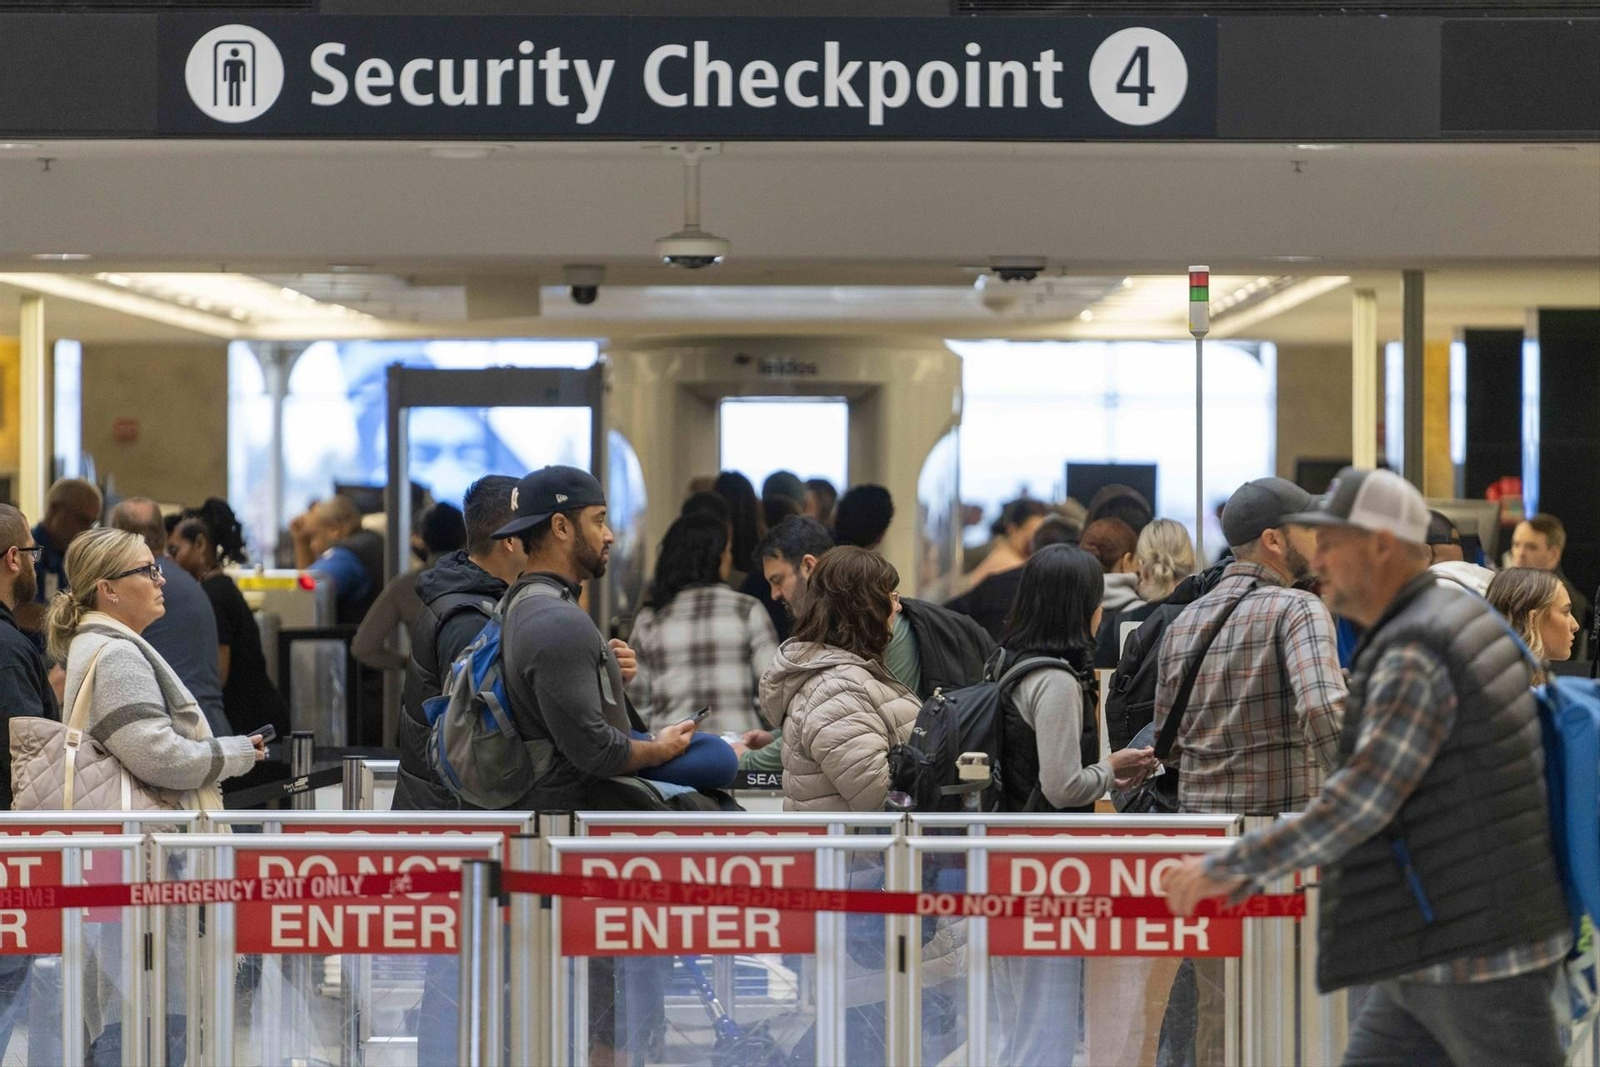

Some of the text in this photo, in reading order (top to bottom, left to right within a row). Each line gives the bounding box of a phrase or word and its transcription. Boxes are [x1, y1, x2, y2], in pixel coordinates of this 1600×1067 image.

[310, 40, 1155, 126] Security Checkpoint 4
[747, 774, 778, 785] SEA
[130, 875, 364, 904] EMERGENCY EXIT ONLY
[1010, 857, 1091, 896] DO
[916, 893, 1113, 918] DO NOT ENTER
[271, 905, 457, 948] ENTER
[595, 906, 781, 949] ENTER
[1023, 916, 1210, 950] ENTER
